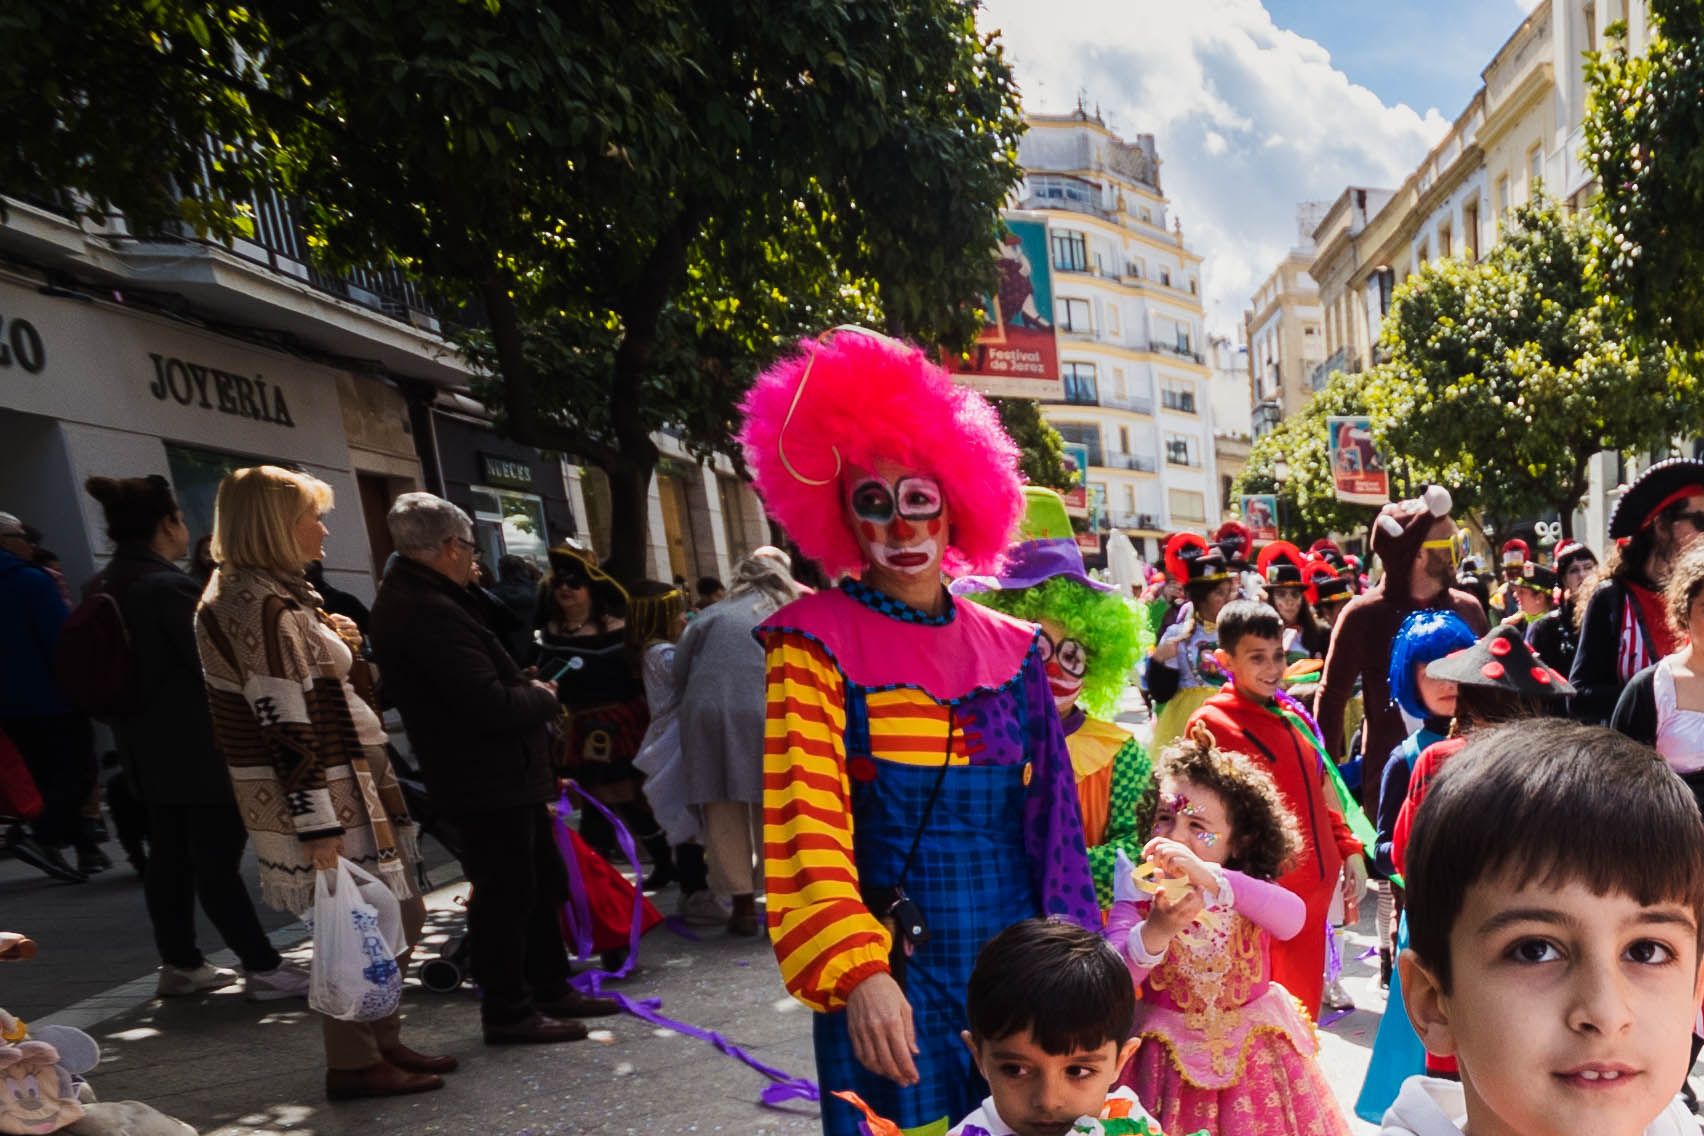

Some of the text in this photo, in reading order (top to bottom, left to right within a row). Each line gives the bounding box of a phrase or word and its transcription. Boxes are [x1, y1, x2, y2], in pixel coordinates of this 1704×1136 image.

[989, 348, 1041, 362] Festival
[990, 361, 1045, 374] de Jerez
[148, 352, 295, 428] JOYERÍA
